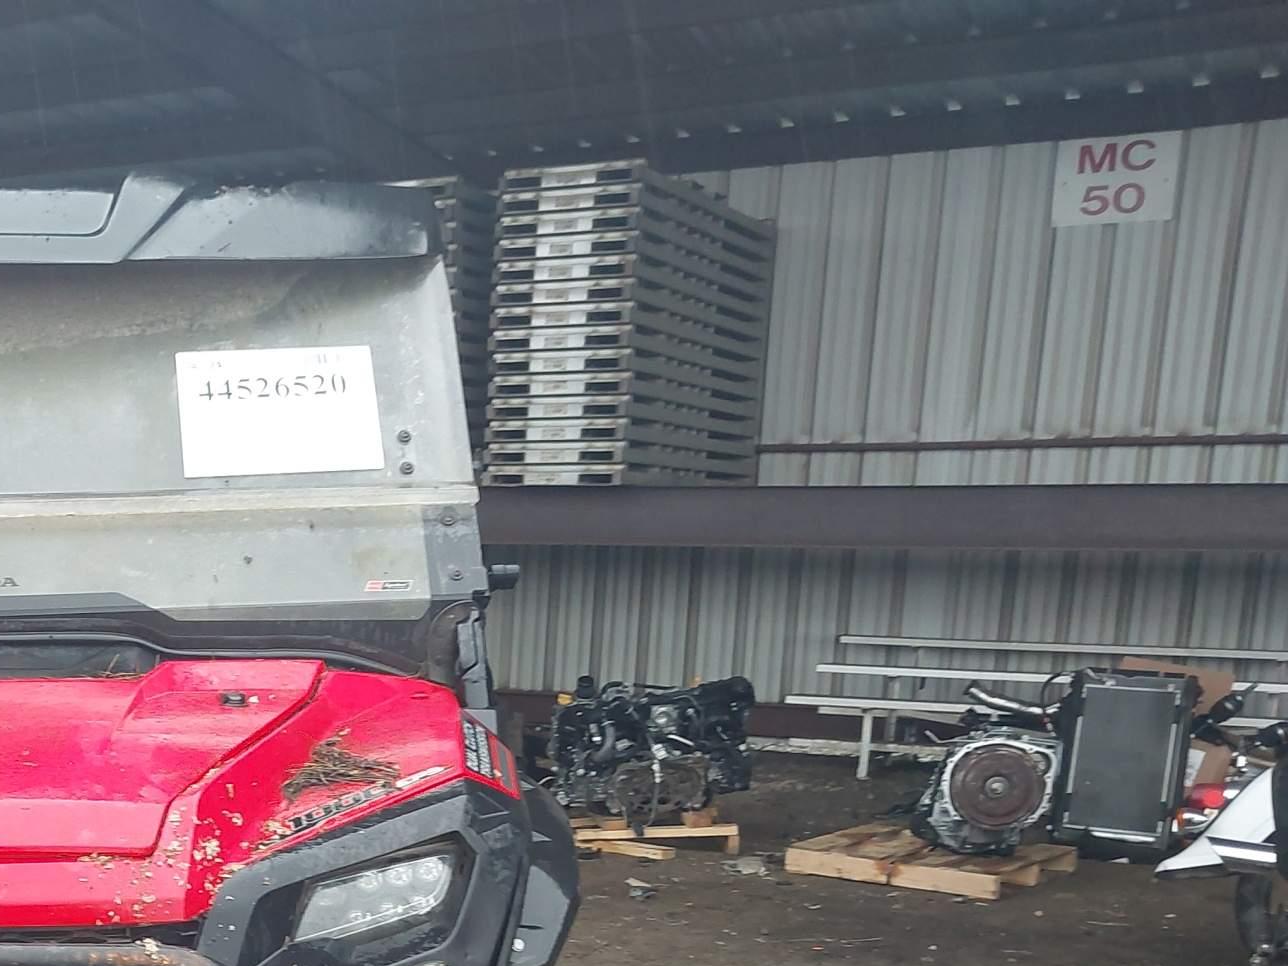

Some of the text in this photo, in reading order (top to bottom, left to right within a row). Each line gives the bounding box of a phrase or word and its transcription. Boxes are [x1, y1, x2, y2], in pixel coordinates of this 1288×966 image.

[1077, 140, 1157, 174] MC
[1080, 182, 1145, 216] 50
[199, 374, 347, 401] 44526520
